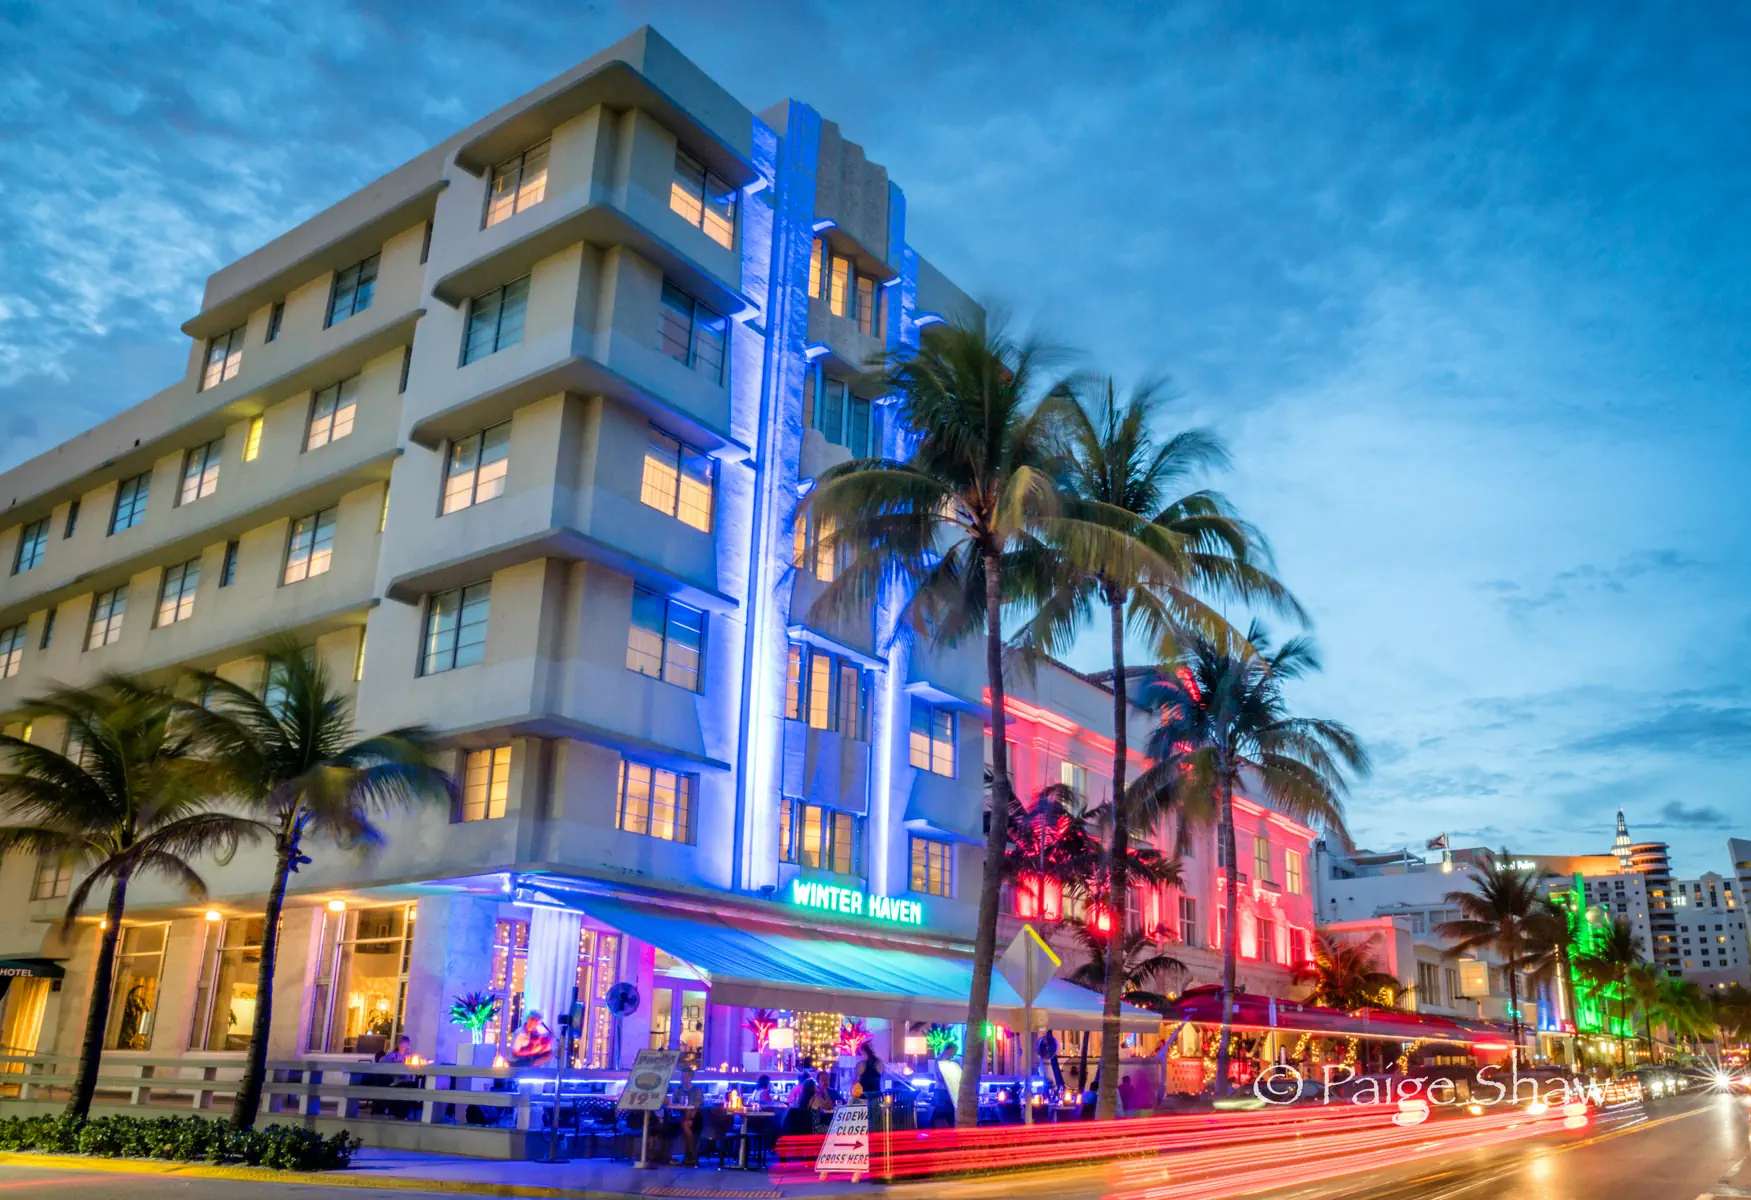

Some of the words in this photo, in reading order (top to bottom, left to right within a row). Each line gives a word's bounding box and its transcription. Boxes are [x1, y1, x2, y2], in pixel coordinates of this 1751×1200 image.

[1516, 860, 1536, 870] Palm
[793, 878, 863, 915] WINTER
[868, 894, 922, 925] HAVEN
[0, 968, 34, 977] HOTEL
[819, 1153, 846, 1164] CROSS
[847, 1154, 869, 1165] HERE
